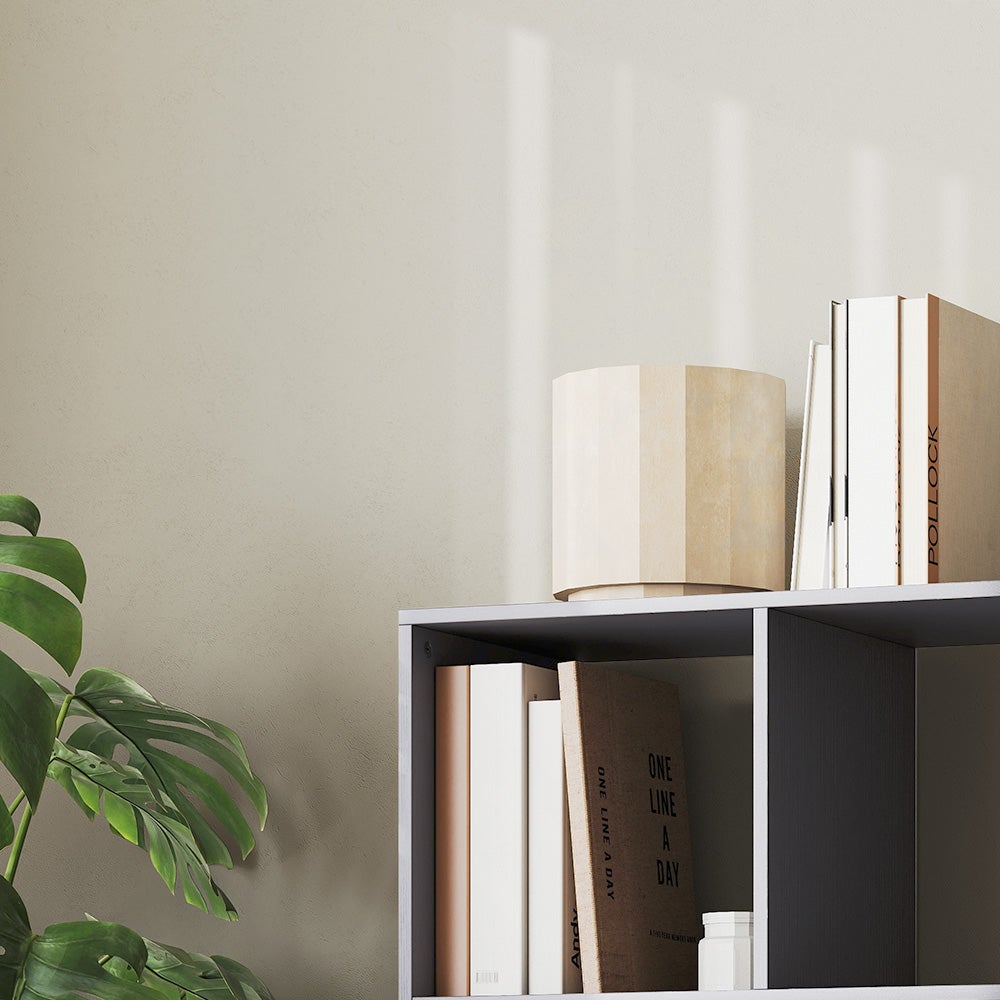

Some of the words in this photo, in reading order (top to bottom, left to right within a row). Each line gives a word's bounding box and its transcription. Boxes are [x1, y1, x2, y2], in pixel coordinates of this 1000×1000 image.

[927, 424, 939, 566] POLLOCK
[648, 753, 672, 781] ONE
[597, 766, 607, 800] ONE
[649, 788, 677, 817] LINE
[600, 807, 611, 845] LINE
[663, 825, 670, 851] A
[604, 851, 612, 861] A
[605, 867, 615, 900] DAY
[656, 860, 679, 887] DAY
